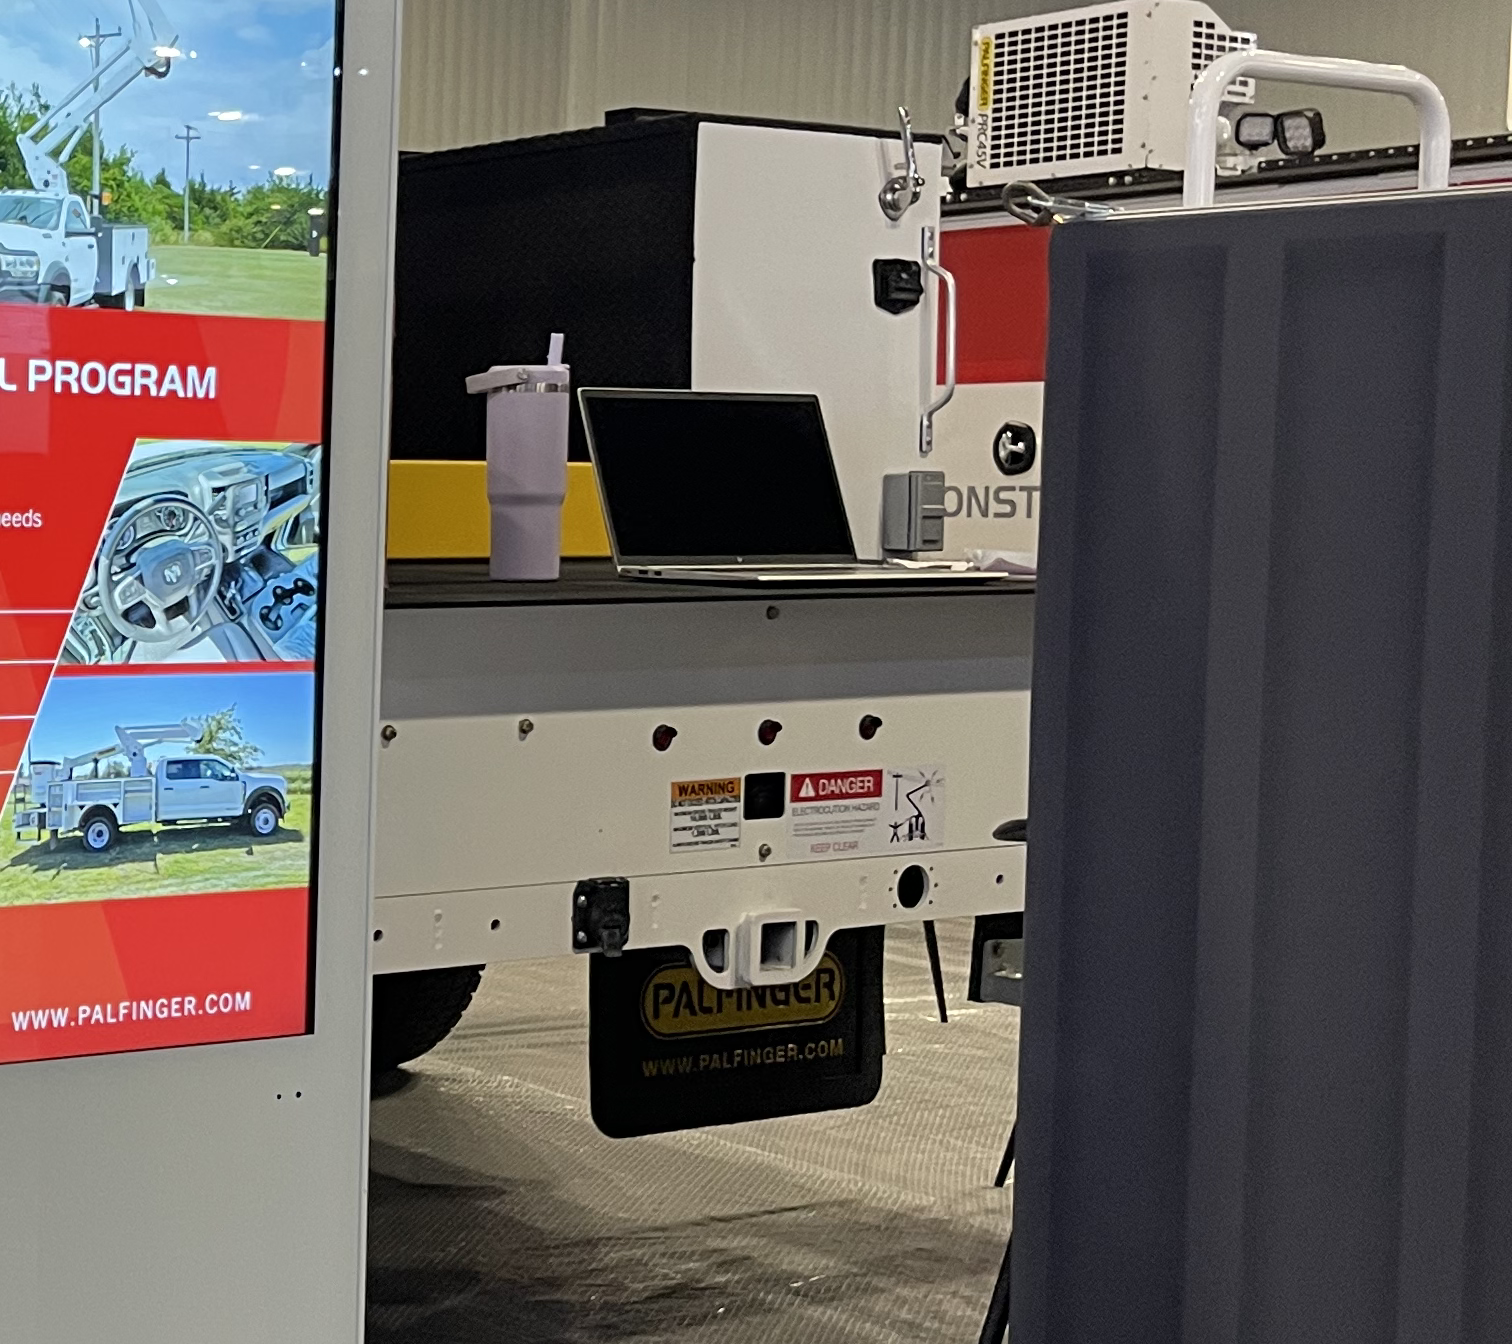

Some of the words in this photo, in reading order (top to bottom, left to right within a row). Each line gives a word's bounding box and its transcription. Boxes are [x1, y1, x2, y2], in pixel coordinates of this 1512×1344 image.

[28, 359, 216, 399] PROGRAM
[677, 781, 735, 798] WARNING
[818, 776, 874, 796] DANGER
[11, 991, 252, 1032] WWW.PALFINGER.COM
[641, 1037, 845, 1078] WWW.PALFINGER.COM
